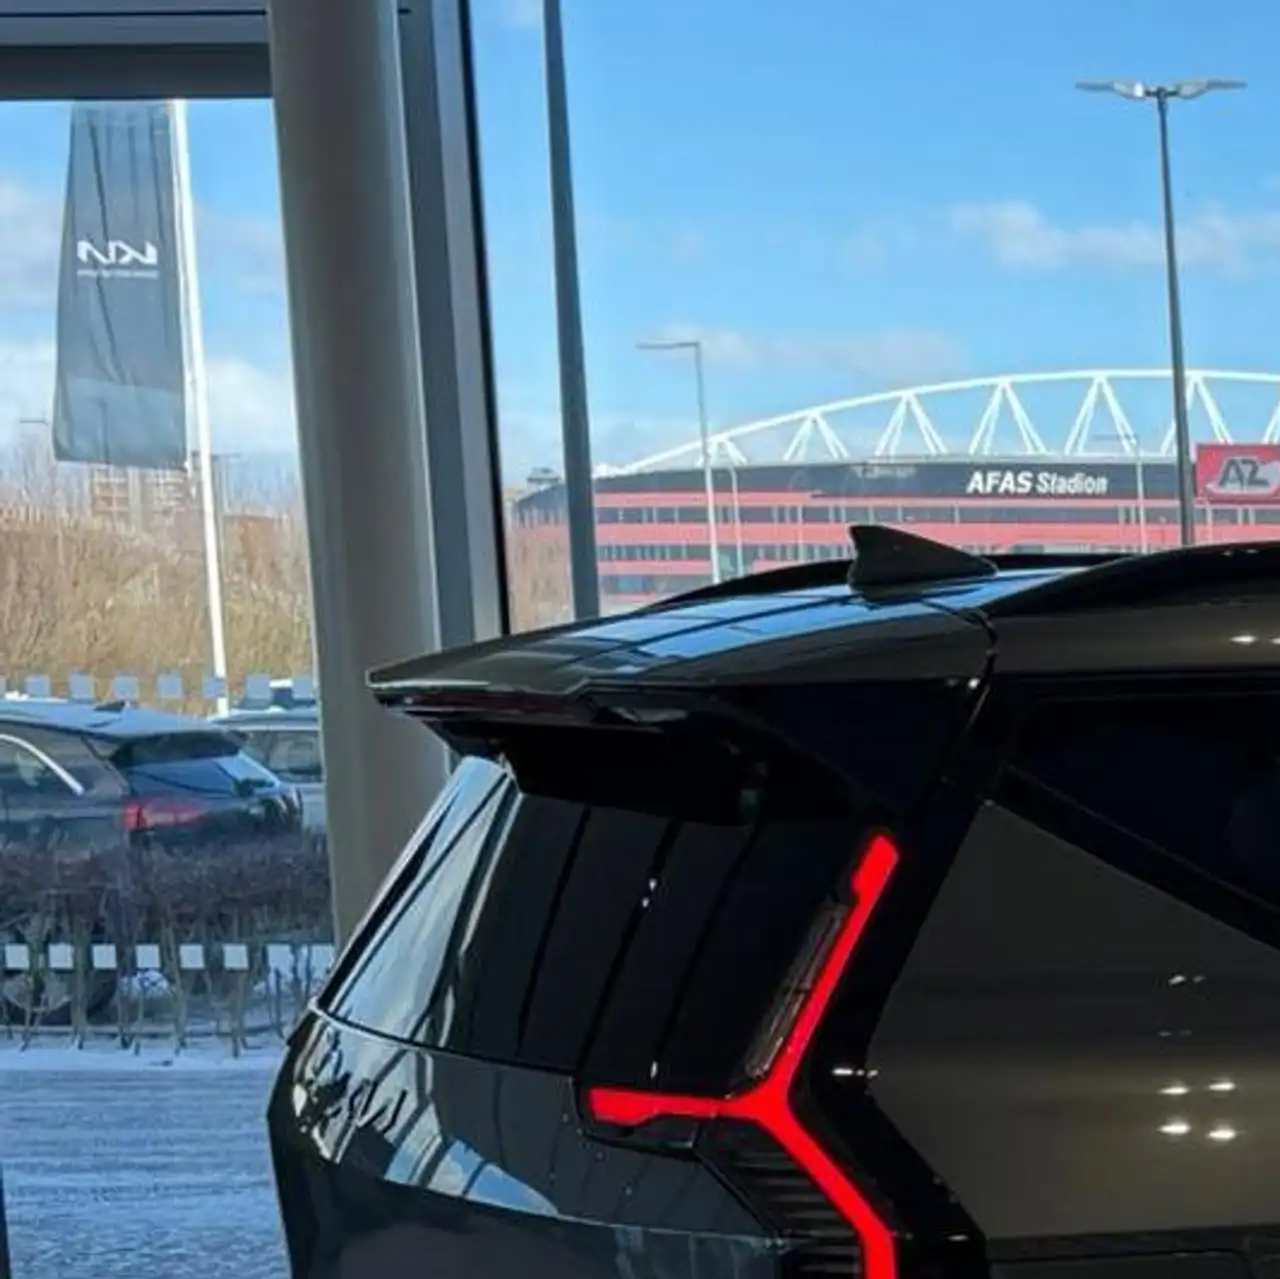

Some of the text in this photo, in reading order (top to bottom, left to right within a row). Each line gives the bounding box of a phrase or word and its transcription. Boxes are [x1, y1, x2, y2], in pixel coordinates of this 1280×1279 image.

[966, 471, 1108, 494] AFAS Stadion
[1219, 458, 1269, 489] AZ
